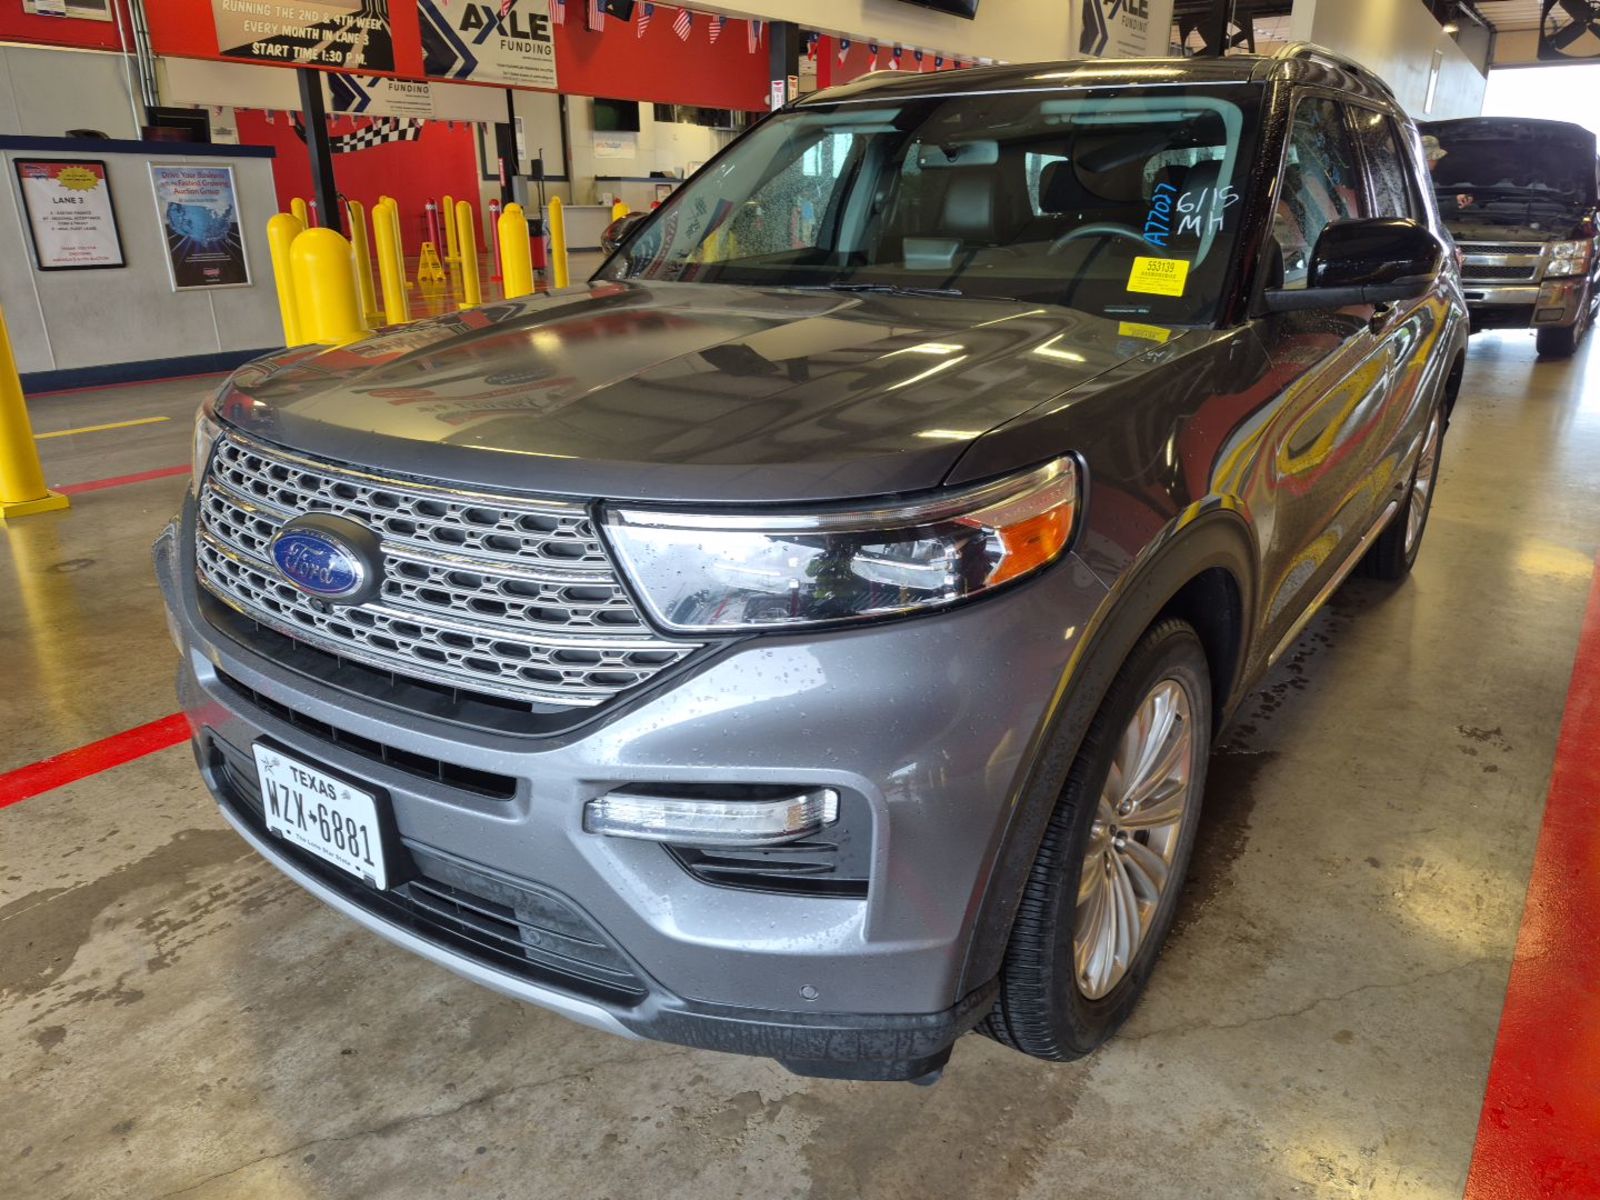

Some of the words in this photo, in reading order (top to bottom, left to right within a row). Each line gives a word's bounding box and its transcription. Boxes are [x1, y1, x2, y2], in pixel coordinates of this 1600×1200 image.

[222, 0, 271, 16] RUNNING
[275, 6, 295, 19] THE
[299, 9, 319, 21] 2ND
[323, 12, 331, 24] &
[333, 14, 354, 28] 4TH
[356, 16, 382, 31] WEEK
[1103, 0, 1149, 20] XLE
[244, 20, 278, 34] EVERY
[281, 25, 320, 40] MONTH
[322, 29, 334, 41] IN
[335, 31, 360, 45] LANE
[362, 34, 370, 46] 3
[459, 0, 551, 45] AXLE
[252, 42, 288, 58] START
[293, 46, 319, 60] TIME
[322, 49, 343, 63] 1:30
[500, 40, 552, 56] FUNDING
[388, 82, 430, 94] FUNDING
[1143, 183, 1177, 247] A77027
[1146, 260, 1175, 273] 553139
[285, 541, 335, 585] Ford
[289, 766, 337, 801] TEXAS
[296, 833, 307, 842] The
